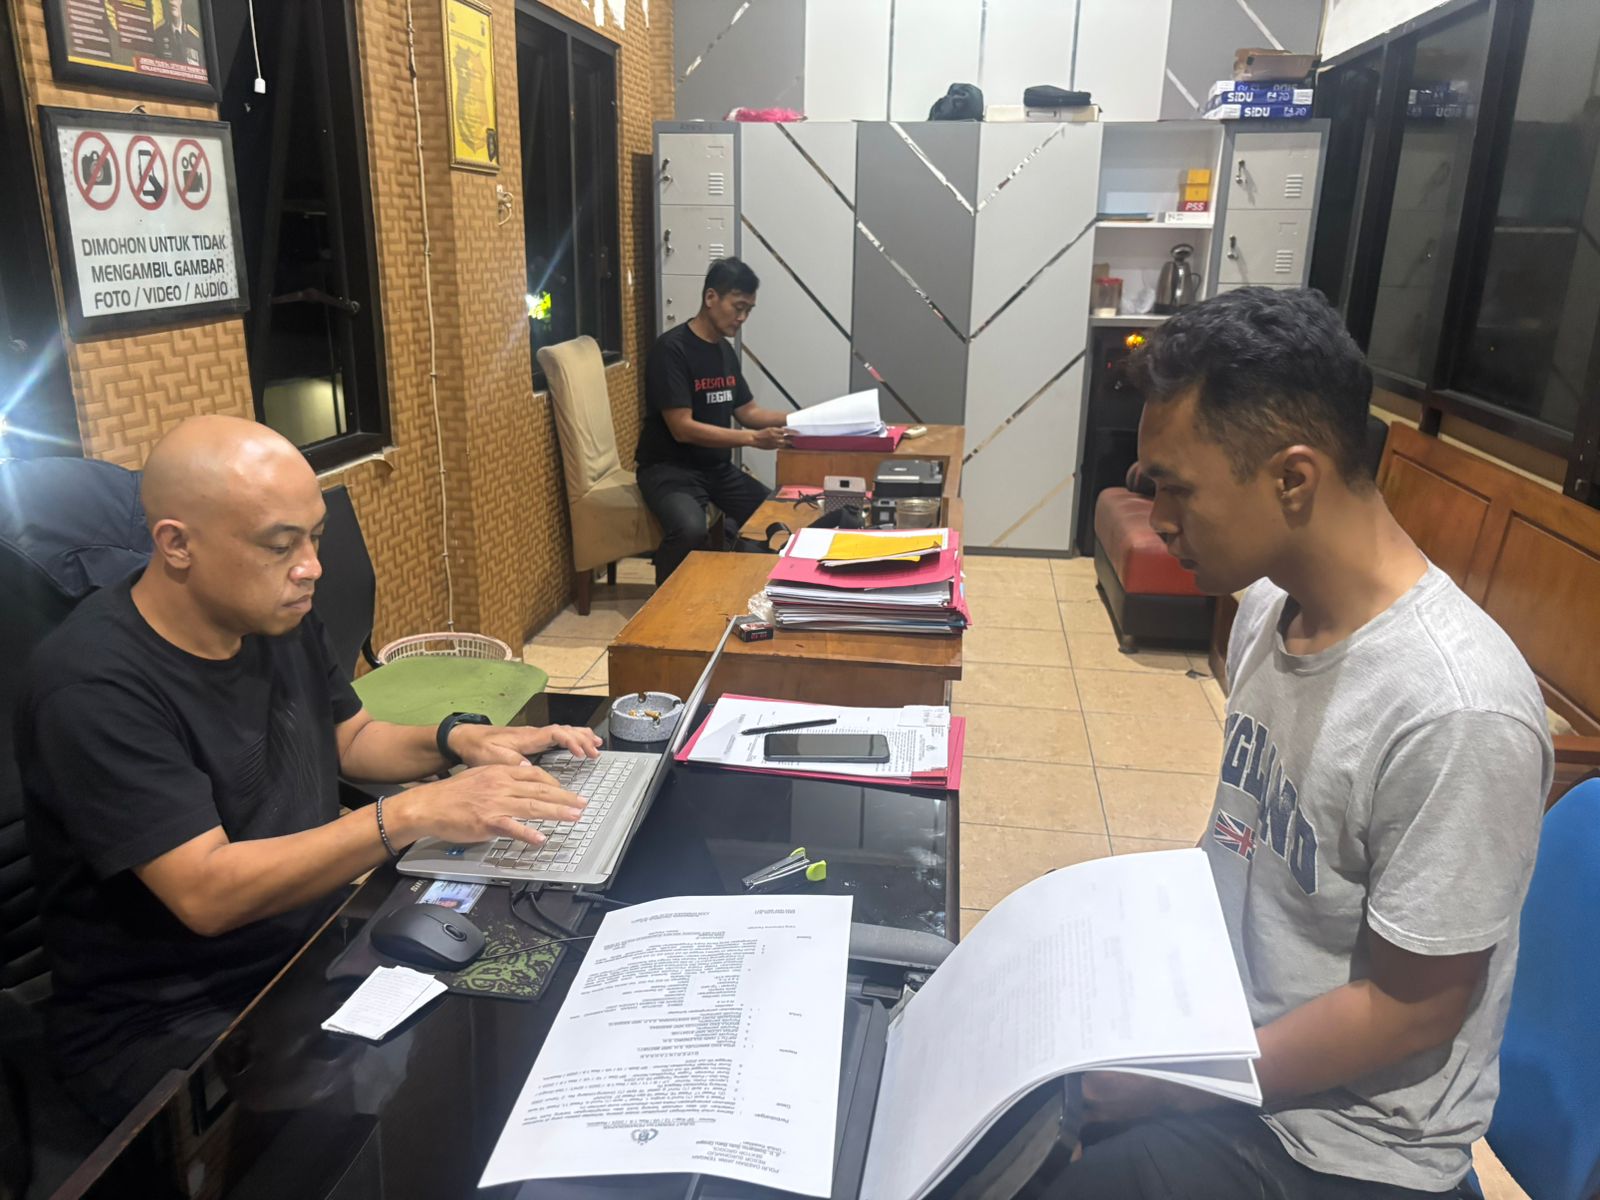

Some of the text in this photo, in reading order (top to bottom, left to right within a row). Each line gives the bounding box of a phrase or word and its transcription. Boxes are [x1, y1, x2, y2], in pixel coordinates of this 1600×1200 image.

[81, 234, 226, 256] DIMOHON UNTUK TIDAK
[91, 258, 224, 283] MENGAMBIL GAMBAR
[94, 290, 130, 309] FOTO
[142, 285, 182, 304] VIDEO
[194, 281, 228, 299] AUDIO
